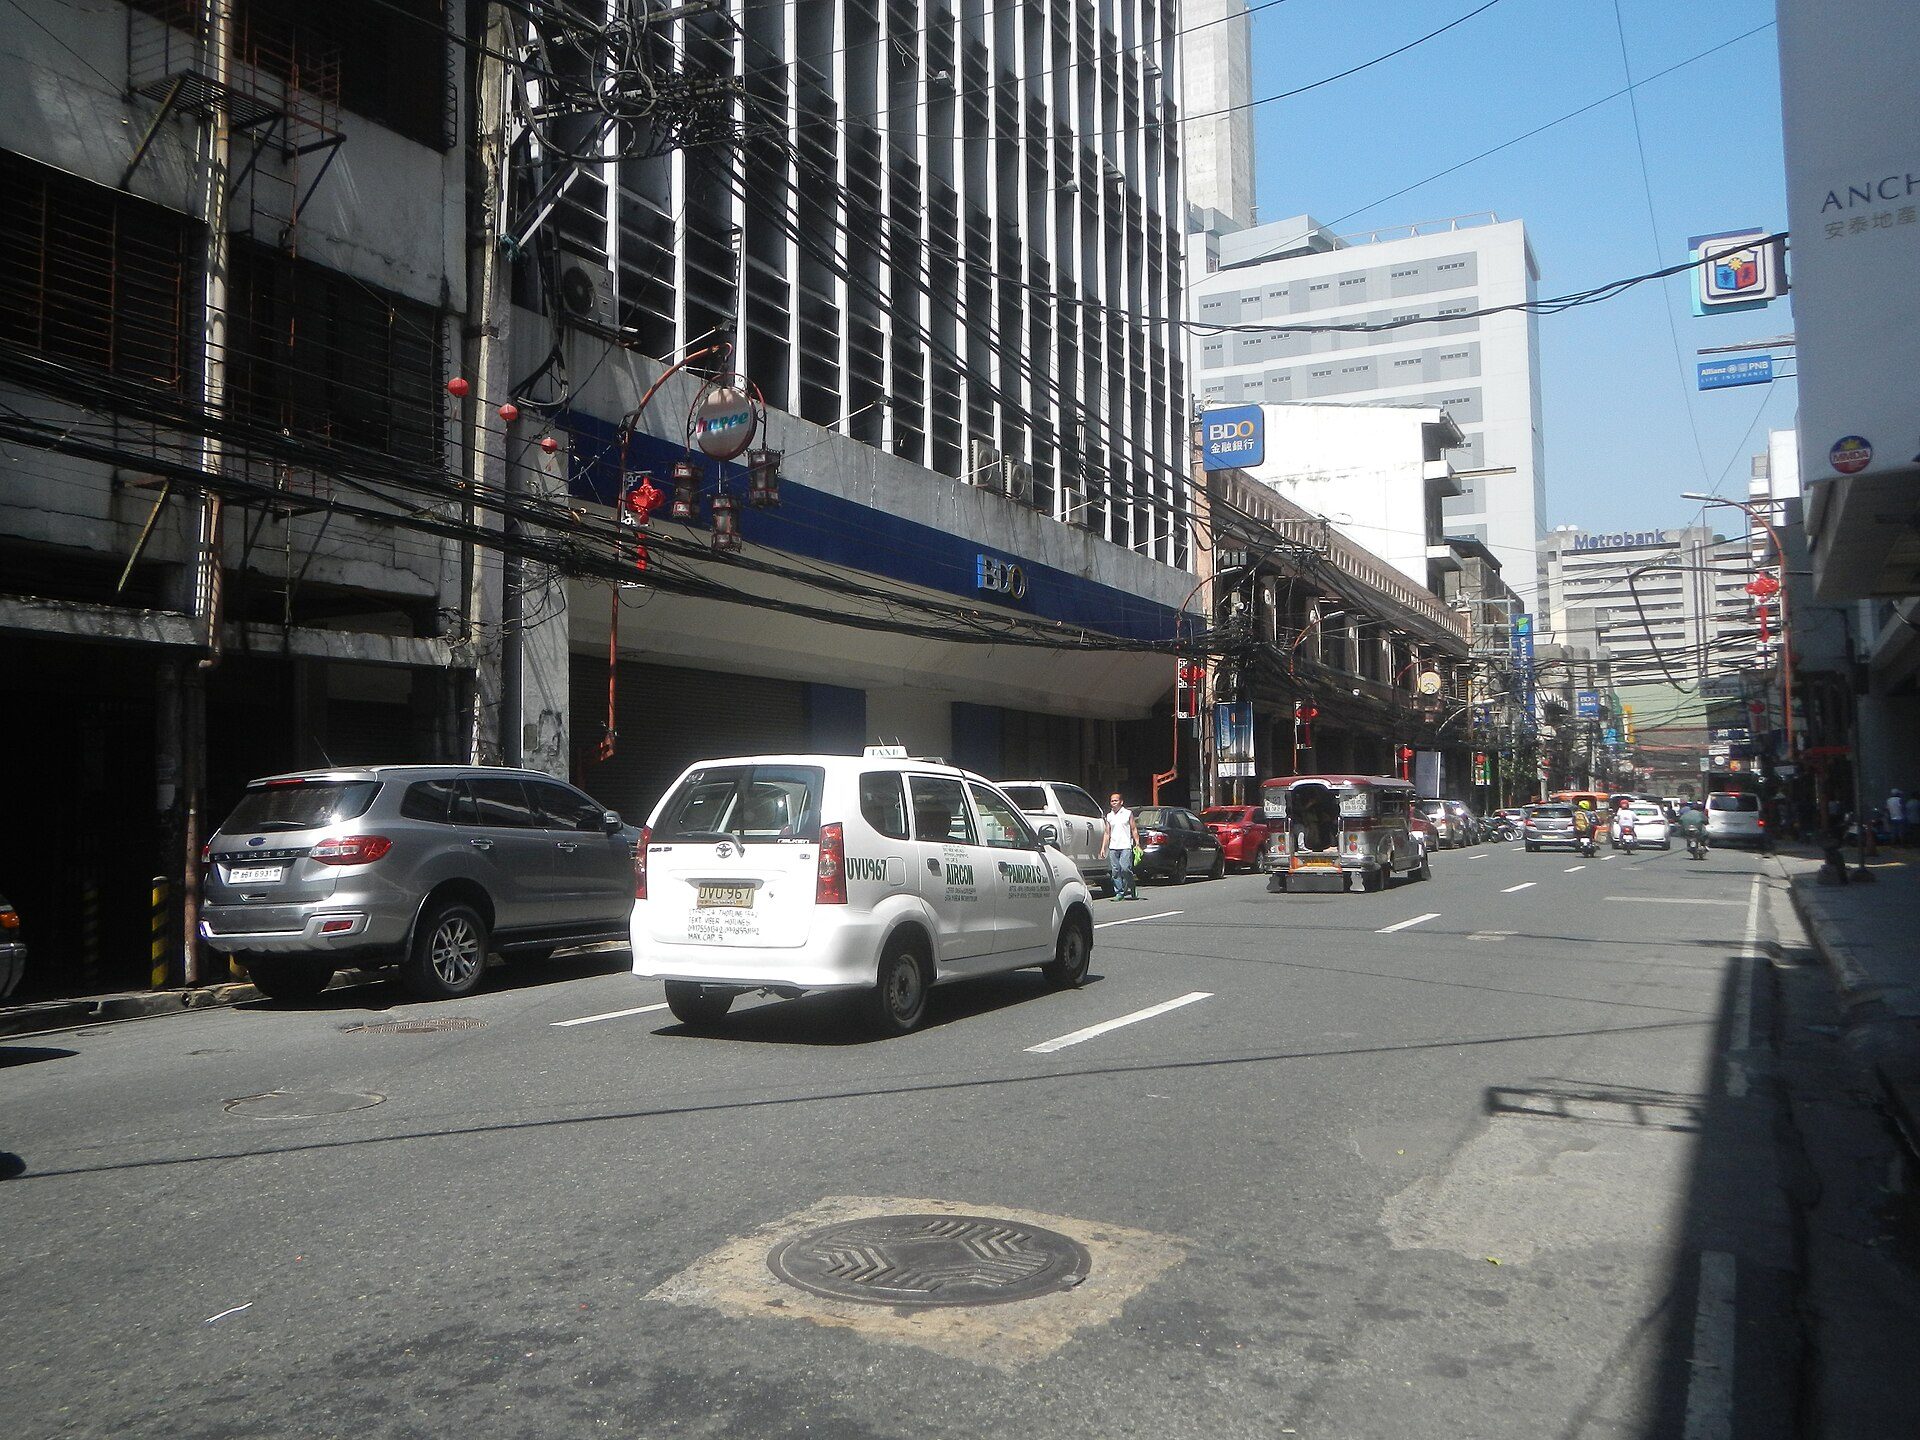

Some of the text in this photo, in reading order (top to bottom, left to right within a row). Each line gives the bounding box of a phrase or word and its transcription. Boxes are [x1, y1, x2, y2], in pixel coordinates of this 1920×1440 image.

[1748, 361, 1769, 370] PNB
[1209, 420, 1255, 441] BDO
[1210, 438, 1255, 454] 金融銀行
[1574, 528, 1667, 550] Metrobank
[976, 554, 1026, 599] BDO
[846, 857, 887, 881] UVU967
[946, 863, 974, 885] AIRCON
